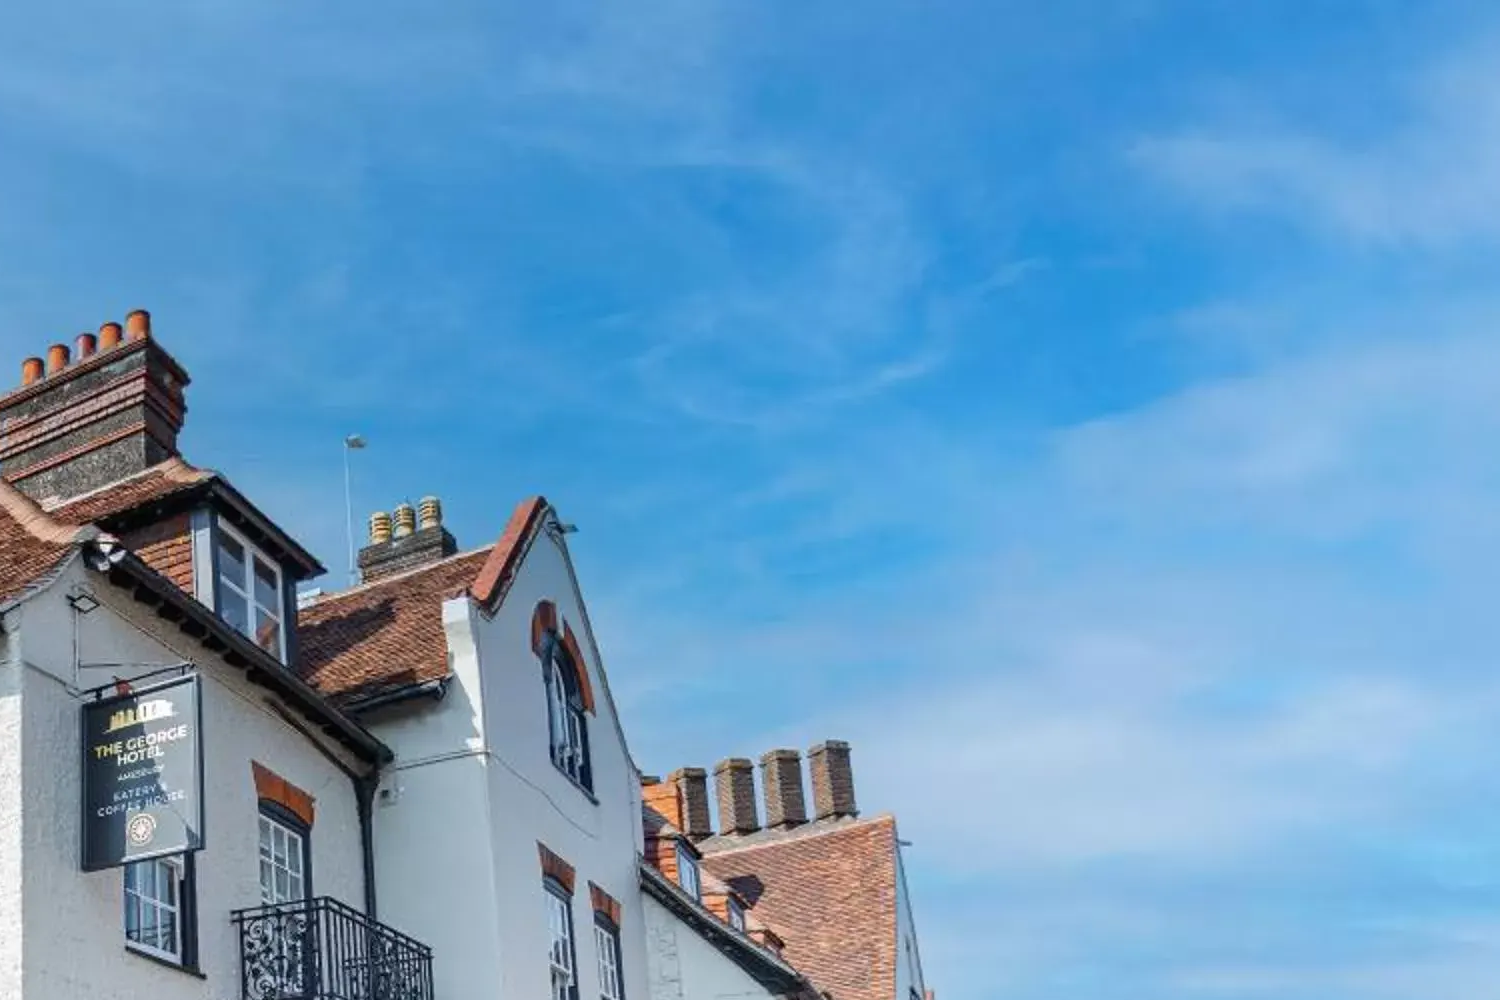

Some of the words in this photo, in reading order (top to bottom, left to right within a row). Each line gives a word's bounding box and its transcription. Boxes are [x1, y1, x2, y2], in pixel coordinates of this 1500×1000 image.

[95, 741, 122, 759] THE
[126, 724, 188, 751] GEORGE
[117, 745, 164, 766] HOTEL
